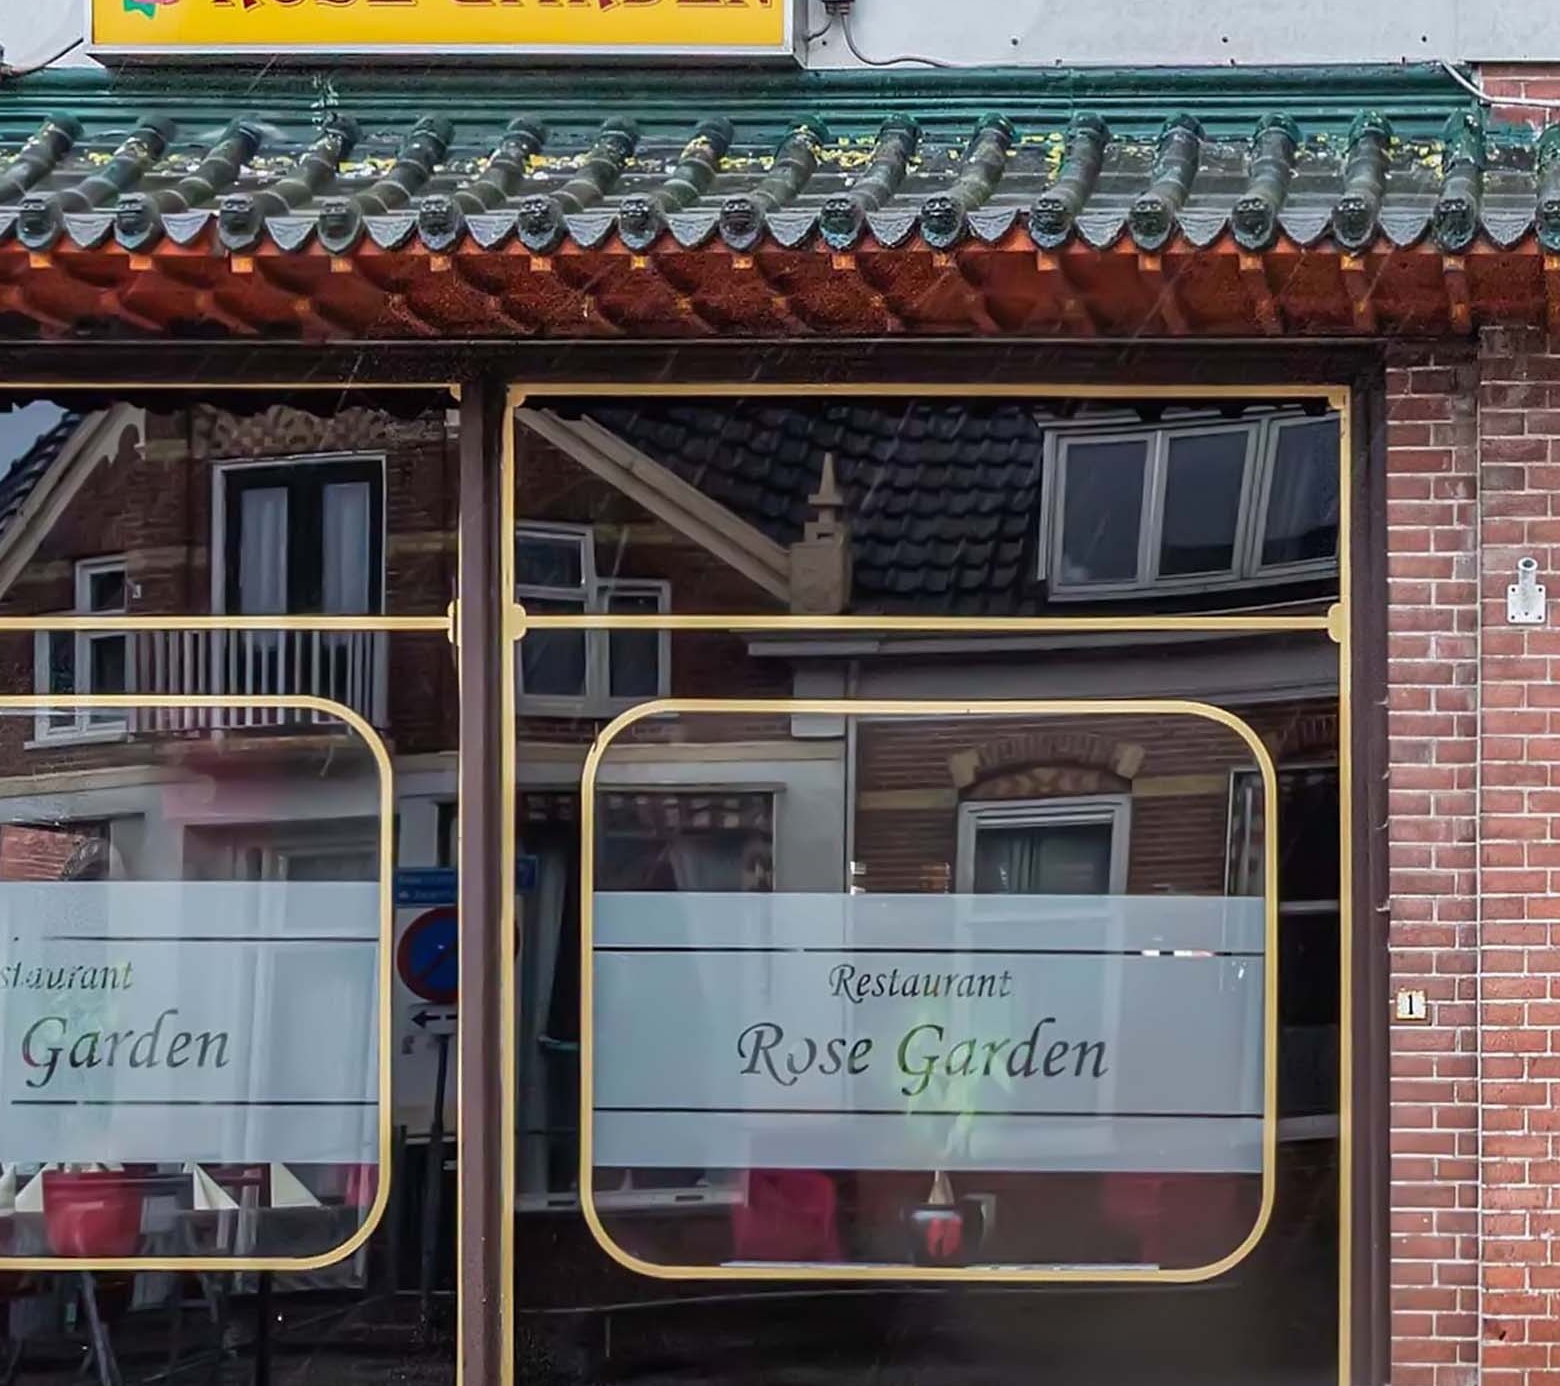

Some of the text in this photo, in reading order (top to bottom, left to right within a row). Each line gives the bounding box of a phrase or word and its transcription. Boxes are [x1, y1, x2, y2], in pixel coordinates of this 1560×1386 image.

[828, 963, 1013, 1004] Restaurant
[21, 1009, 230, 1088] Garden
[737, 1017, 1109, 1096] Rose Garden
